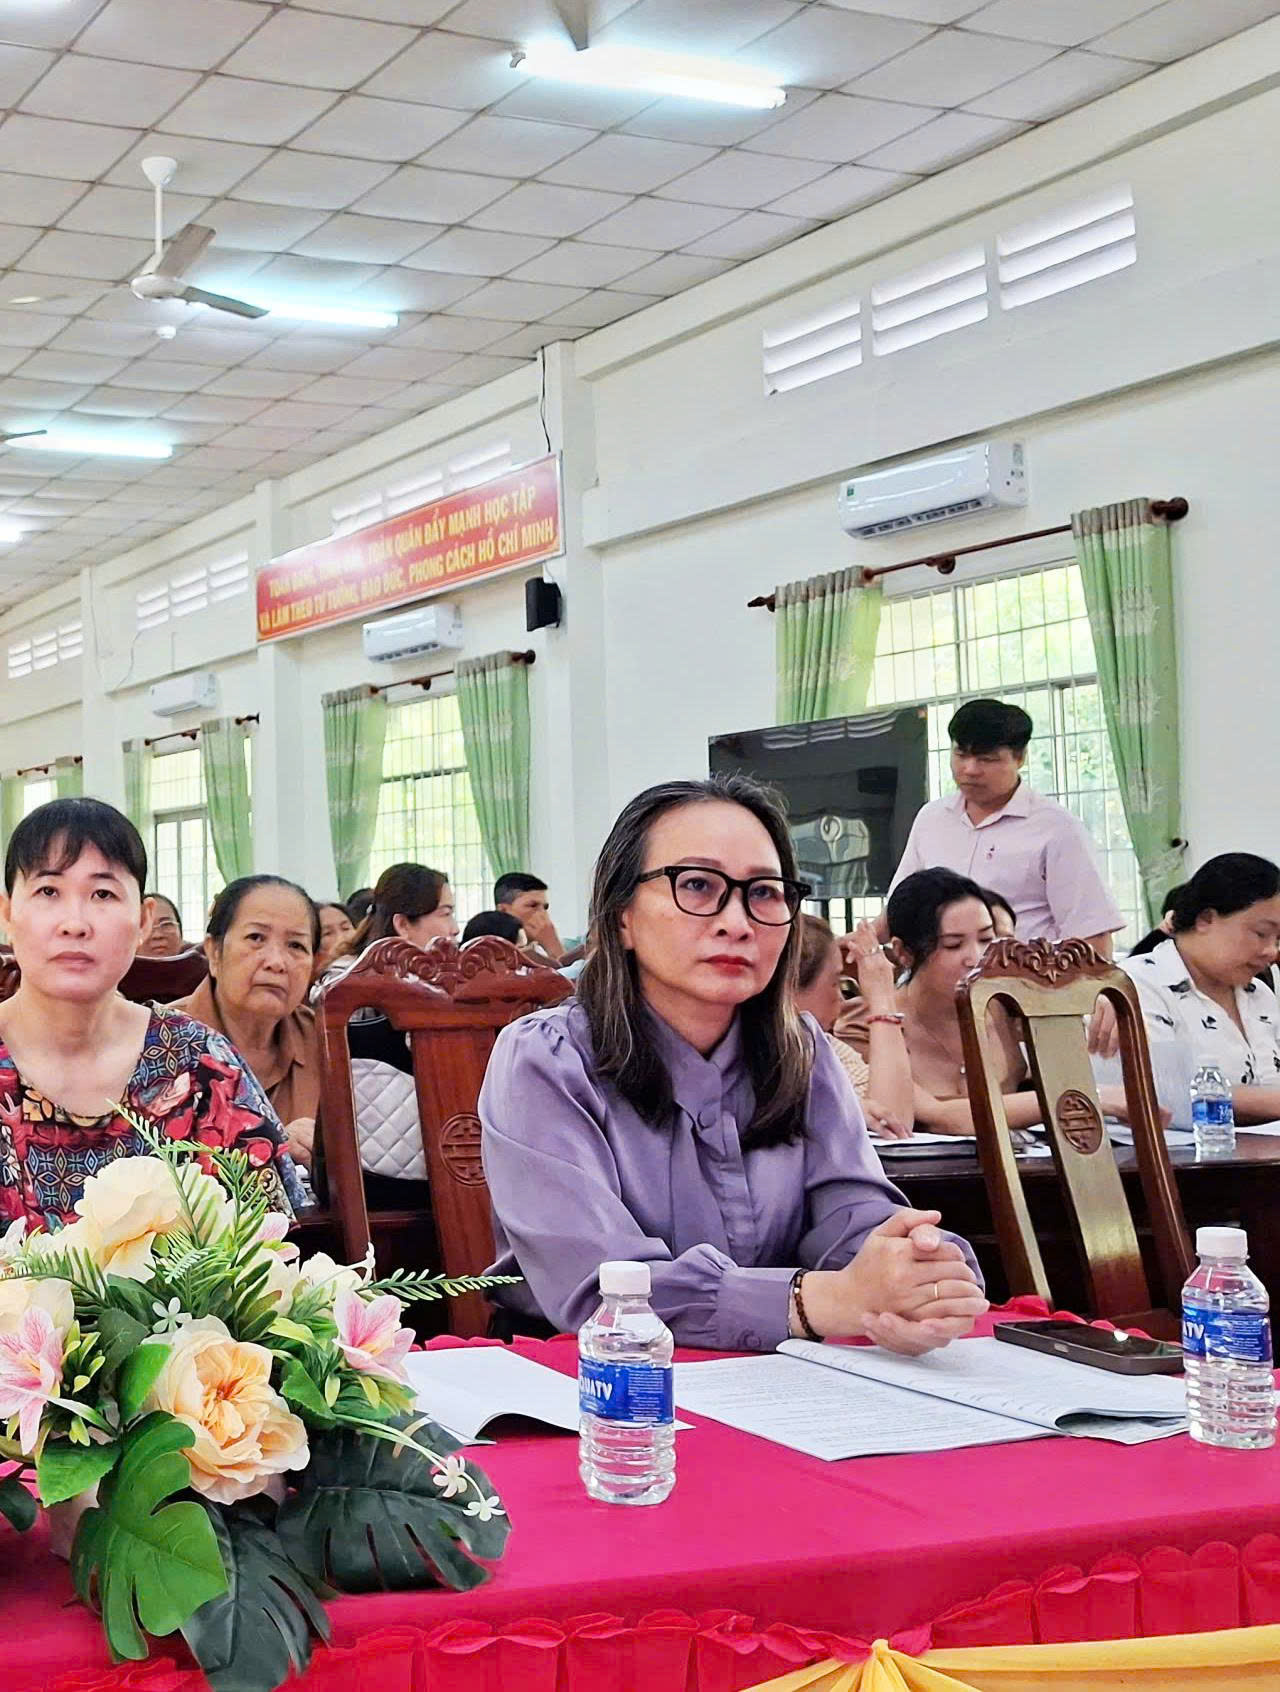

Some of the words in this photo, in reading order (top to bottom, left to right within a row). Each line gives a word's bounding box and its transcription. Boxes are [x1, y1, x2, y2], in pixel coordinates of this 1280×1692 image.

[448, 503, 481, 539] MẠNH
[484, 494, 509, 526] HỌC
[511, 482, 536, 516] TẬP
[408, 553, 445, 584] PHONG
[445, 541, 476, 573] CÁCH
[478, 526, 495, 563] HỒ
[498, 522, 519, 557] CHÍ
[521, 516, 554, 550] MINH
